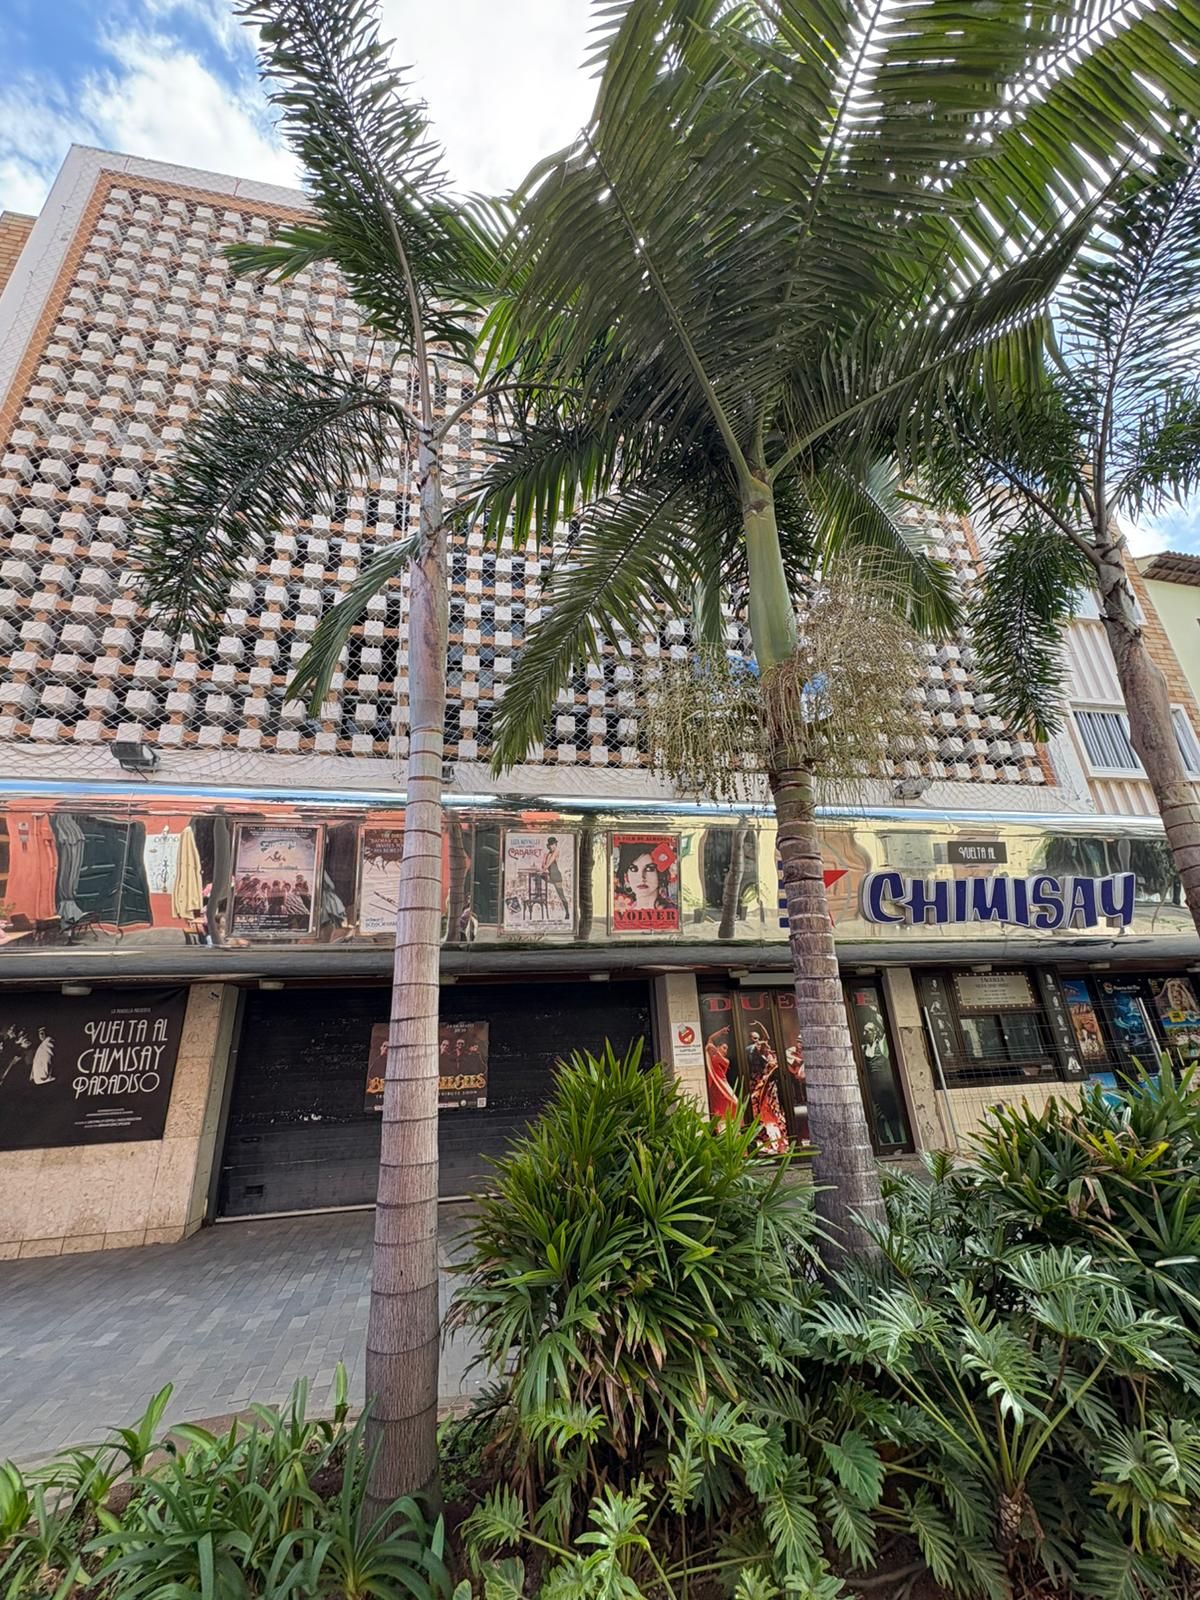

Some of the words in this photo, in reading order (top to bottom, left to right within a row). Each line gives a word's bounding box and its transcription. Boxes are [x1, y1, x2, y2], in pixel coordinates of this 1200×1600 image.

[508, 847, 543, 860] CABARET
[958, 846, 987, 860] VUELTA
[987, 847, 996, 860] AL
[860, 871, 1135, 930] CHIMISAY
[616, 910, 676, 921] VOLVER
[84, 1019, 148, 1044] VUELTA
[152, 1018, 168, 1042] AL
[77, 1045, 167, 1074] CHIMISAY
[72, 1072, 160, 1099] PARADISO
